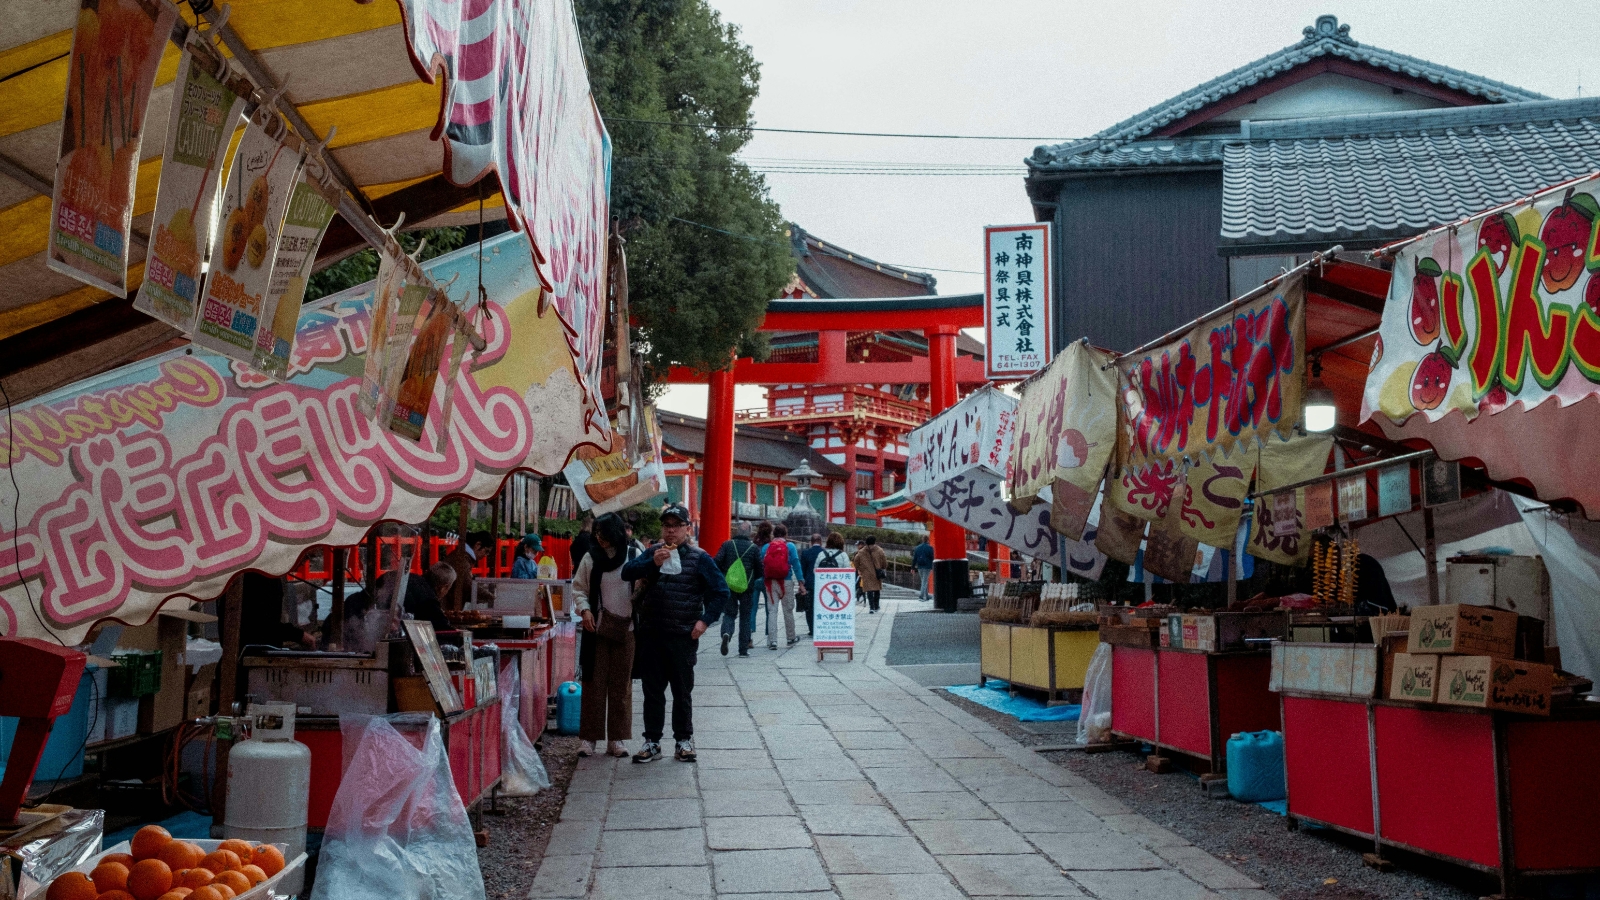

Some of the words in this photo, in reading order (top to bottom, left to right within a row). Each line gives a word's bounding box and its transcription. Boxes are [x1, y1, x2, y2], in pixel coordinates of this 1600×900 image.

[995, 252, 1011, 327] 神祭具一式
[1015, 233, 1034, 353] 南神具株式會社
[997, 361, 1041, 369] 641-1307
[924, 406, 978, 482] 焼だんご
